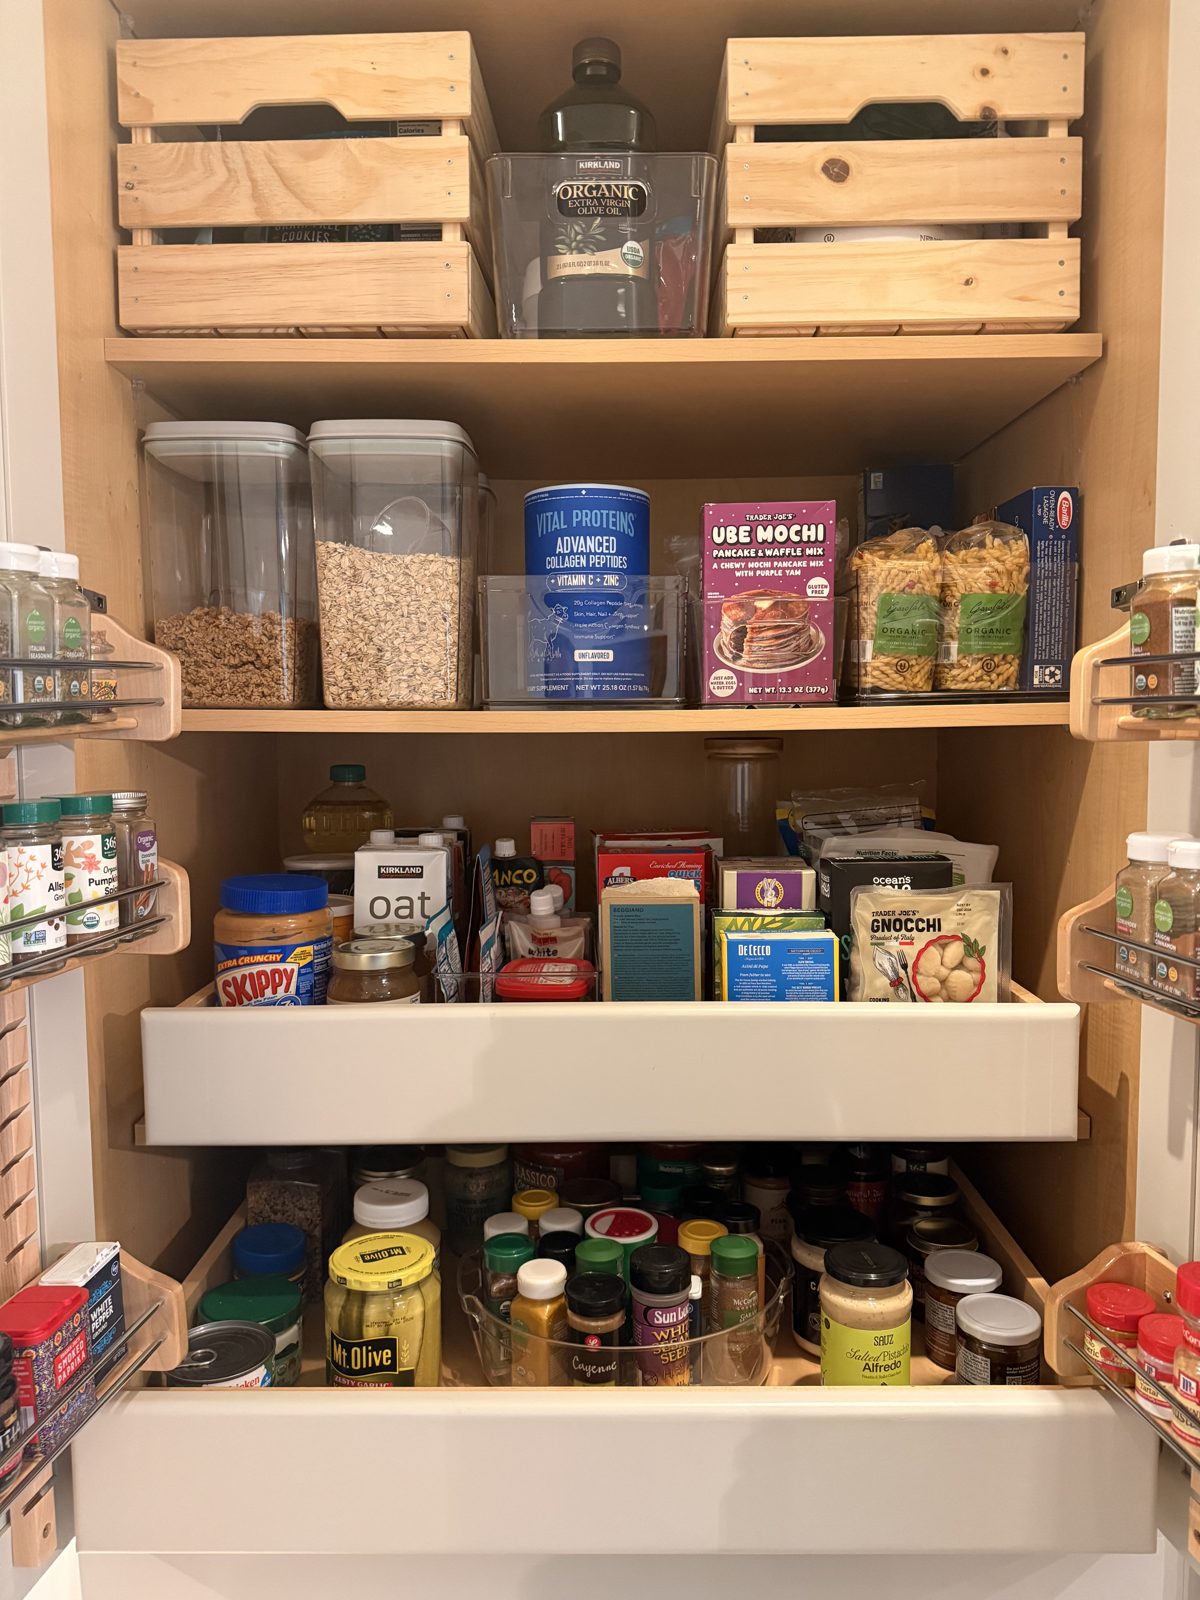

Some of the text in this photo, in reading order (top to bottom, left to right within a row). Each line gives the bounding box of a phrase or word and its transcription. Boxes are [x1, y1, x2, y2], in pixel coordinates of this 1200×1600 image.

[398, 127, 425, 135] Calories
[579, 161, 621, 169] KIRKLAND
[559, 184, 639, 201] ORGANIC
[568, 199, 631, 208] EXTRA VIRGIN
[577, 206, 622, 216] OLIVE OIL
[281, 231, 331, 244] COOKIES
[626, 246, 641, 254] USDA
[1048, 489, 1056, 531] OVEN-READY
[1061, 499, 1070, 526] Barilla
[537, 510, 634, 538] VITAL PROTEINS
[712, 523, 825, 544] UBE MOCHI
[556, 536, 617, 554] ADVANCED
[713, 547, 824, 558] PANCAKE & WAFFLE MIX
[546, 555, 627, 569] COLLAGEN PEPTIDES
[557, 575, 619, 586] VITAMIN C ZINC
[881, 626, 927, 636] ORGANIC
[966, 627, 1011, 635] ORGANIC
[577, 652, 610, 660] UNFLAVORED
[765, 686, 777, 694] WT.
[806, 685, 829, 694] (377g)
[137, 835, 154, 844] Organic
[649, 860, 703, 870] Enriched Hominy
[493, 868, 537, 886] ANCO
[668, 870, 702, 878] QUICK
[873, 875, 911, 885] ocean's
[607, 876, 634, 886] ALBERS
[369, 892, 431, 920] oat
[871, 917, 942, 933] GNOCCHI
[893, 934, 900, 942] of
[900, 934, 915, 942] Italy
[528, 948, 558, 957] white
[217, 958, 238, 972] EXTRA
[238, 953, 284, 967] CRUNCHY
[221, 967, 295, 1007] SKIPPY
[516, 1163, 556, 1188] LASSICO
[90, 1294, 113, 1322] WHITE
[91, 1304, 114, 1333] PEPPER
[654, 1310, 677, 1325] Sun
[873, 1334, 894, 1347] SAUZ
[58, 1340, 84, 1373] SMOKED
[845, 1347, 884, 1362] Salted
[58, 1350, 86, 1386] PAPRIKA
[572, 1355, 618, 1378] Cayenne
[862, 1359, 902, 1373] Alfredo
[335, 1375, 356, 1386] ZESTY
